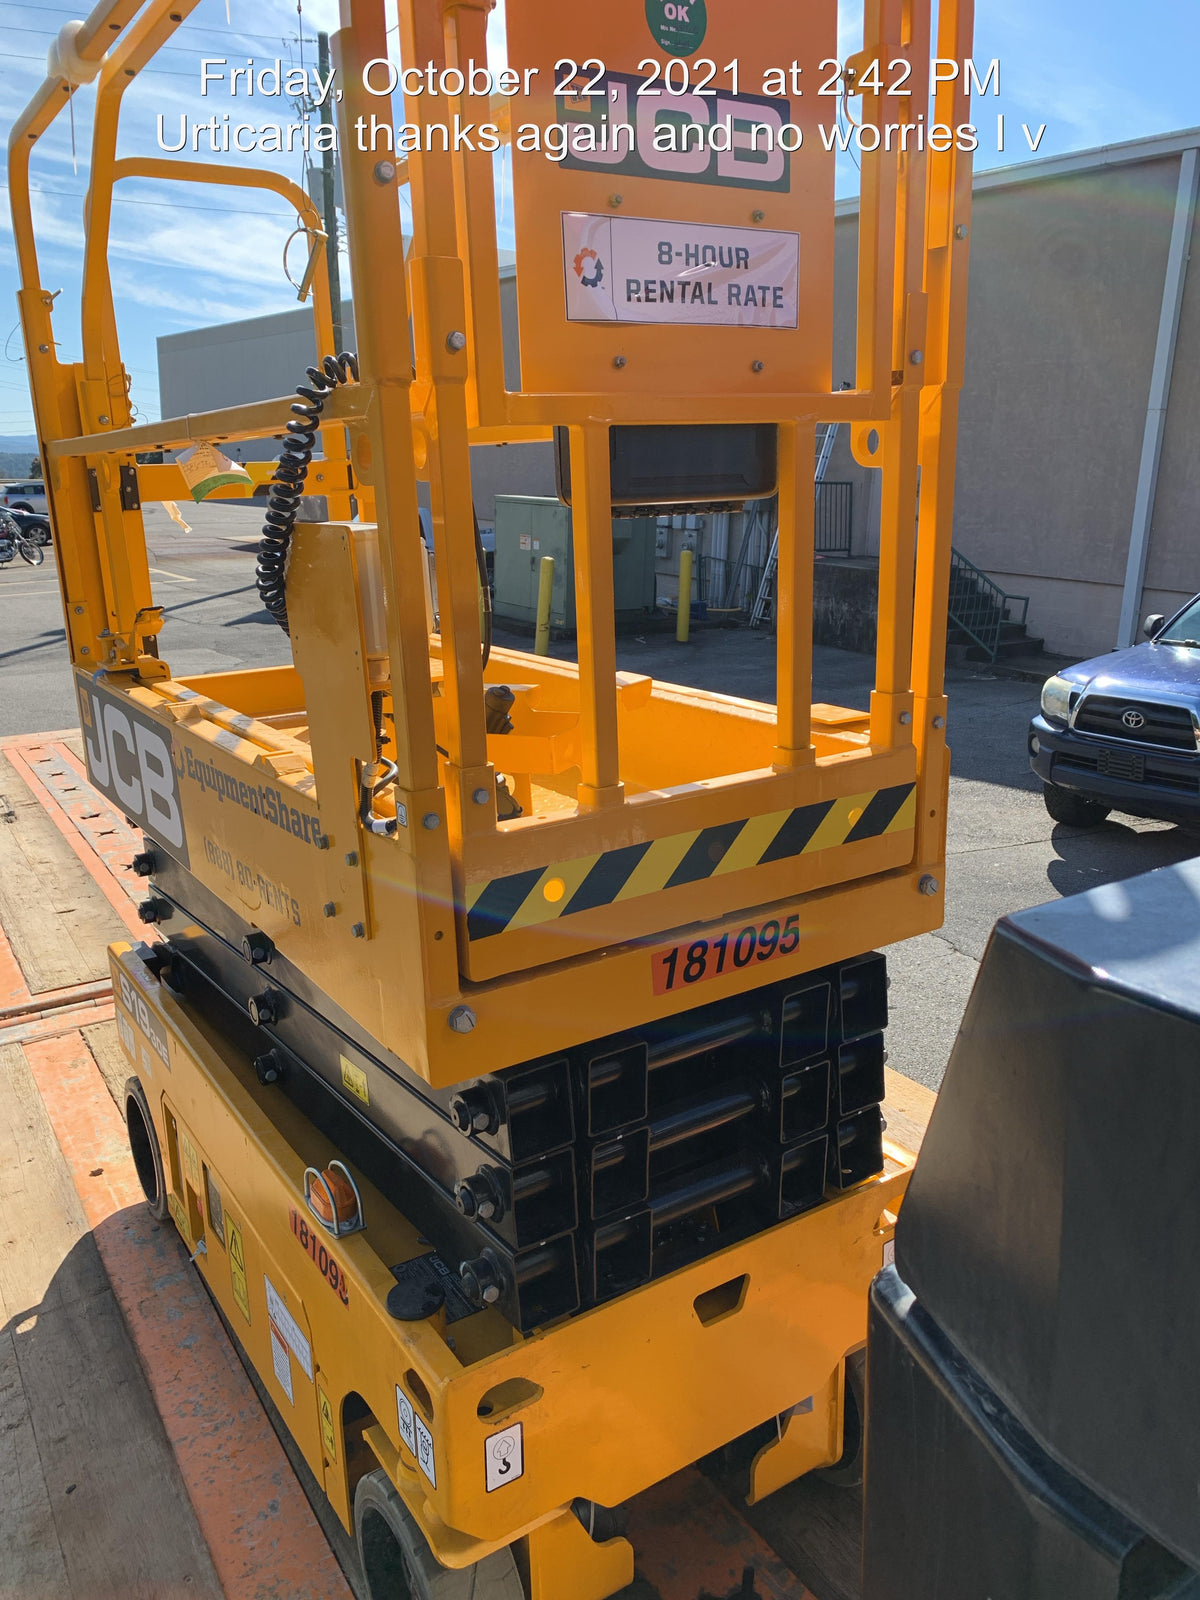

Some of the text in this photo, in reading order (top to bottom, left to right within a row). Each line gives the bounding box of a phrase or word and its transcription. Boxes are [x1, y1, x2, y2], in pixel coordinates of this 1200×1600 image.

[664, 2, 690, 23] OK
[566, 81, 786, 182] JCB
[657, 241, 750, 270] 8-HOUR
[626, 278, 784, 309] RENTAL RATE
[86, 694, 183, 849] JCB
[184, 746, 322, 847] EquipmentShare
[662, 914, 800, 990] 181095
[429, 1255, 451, 1276] JCB
